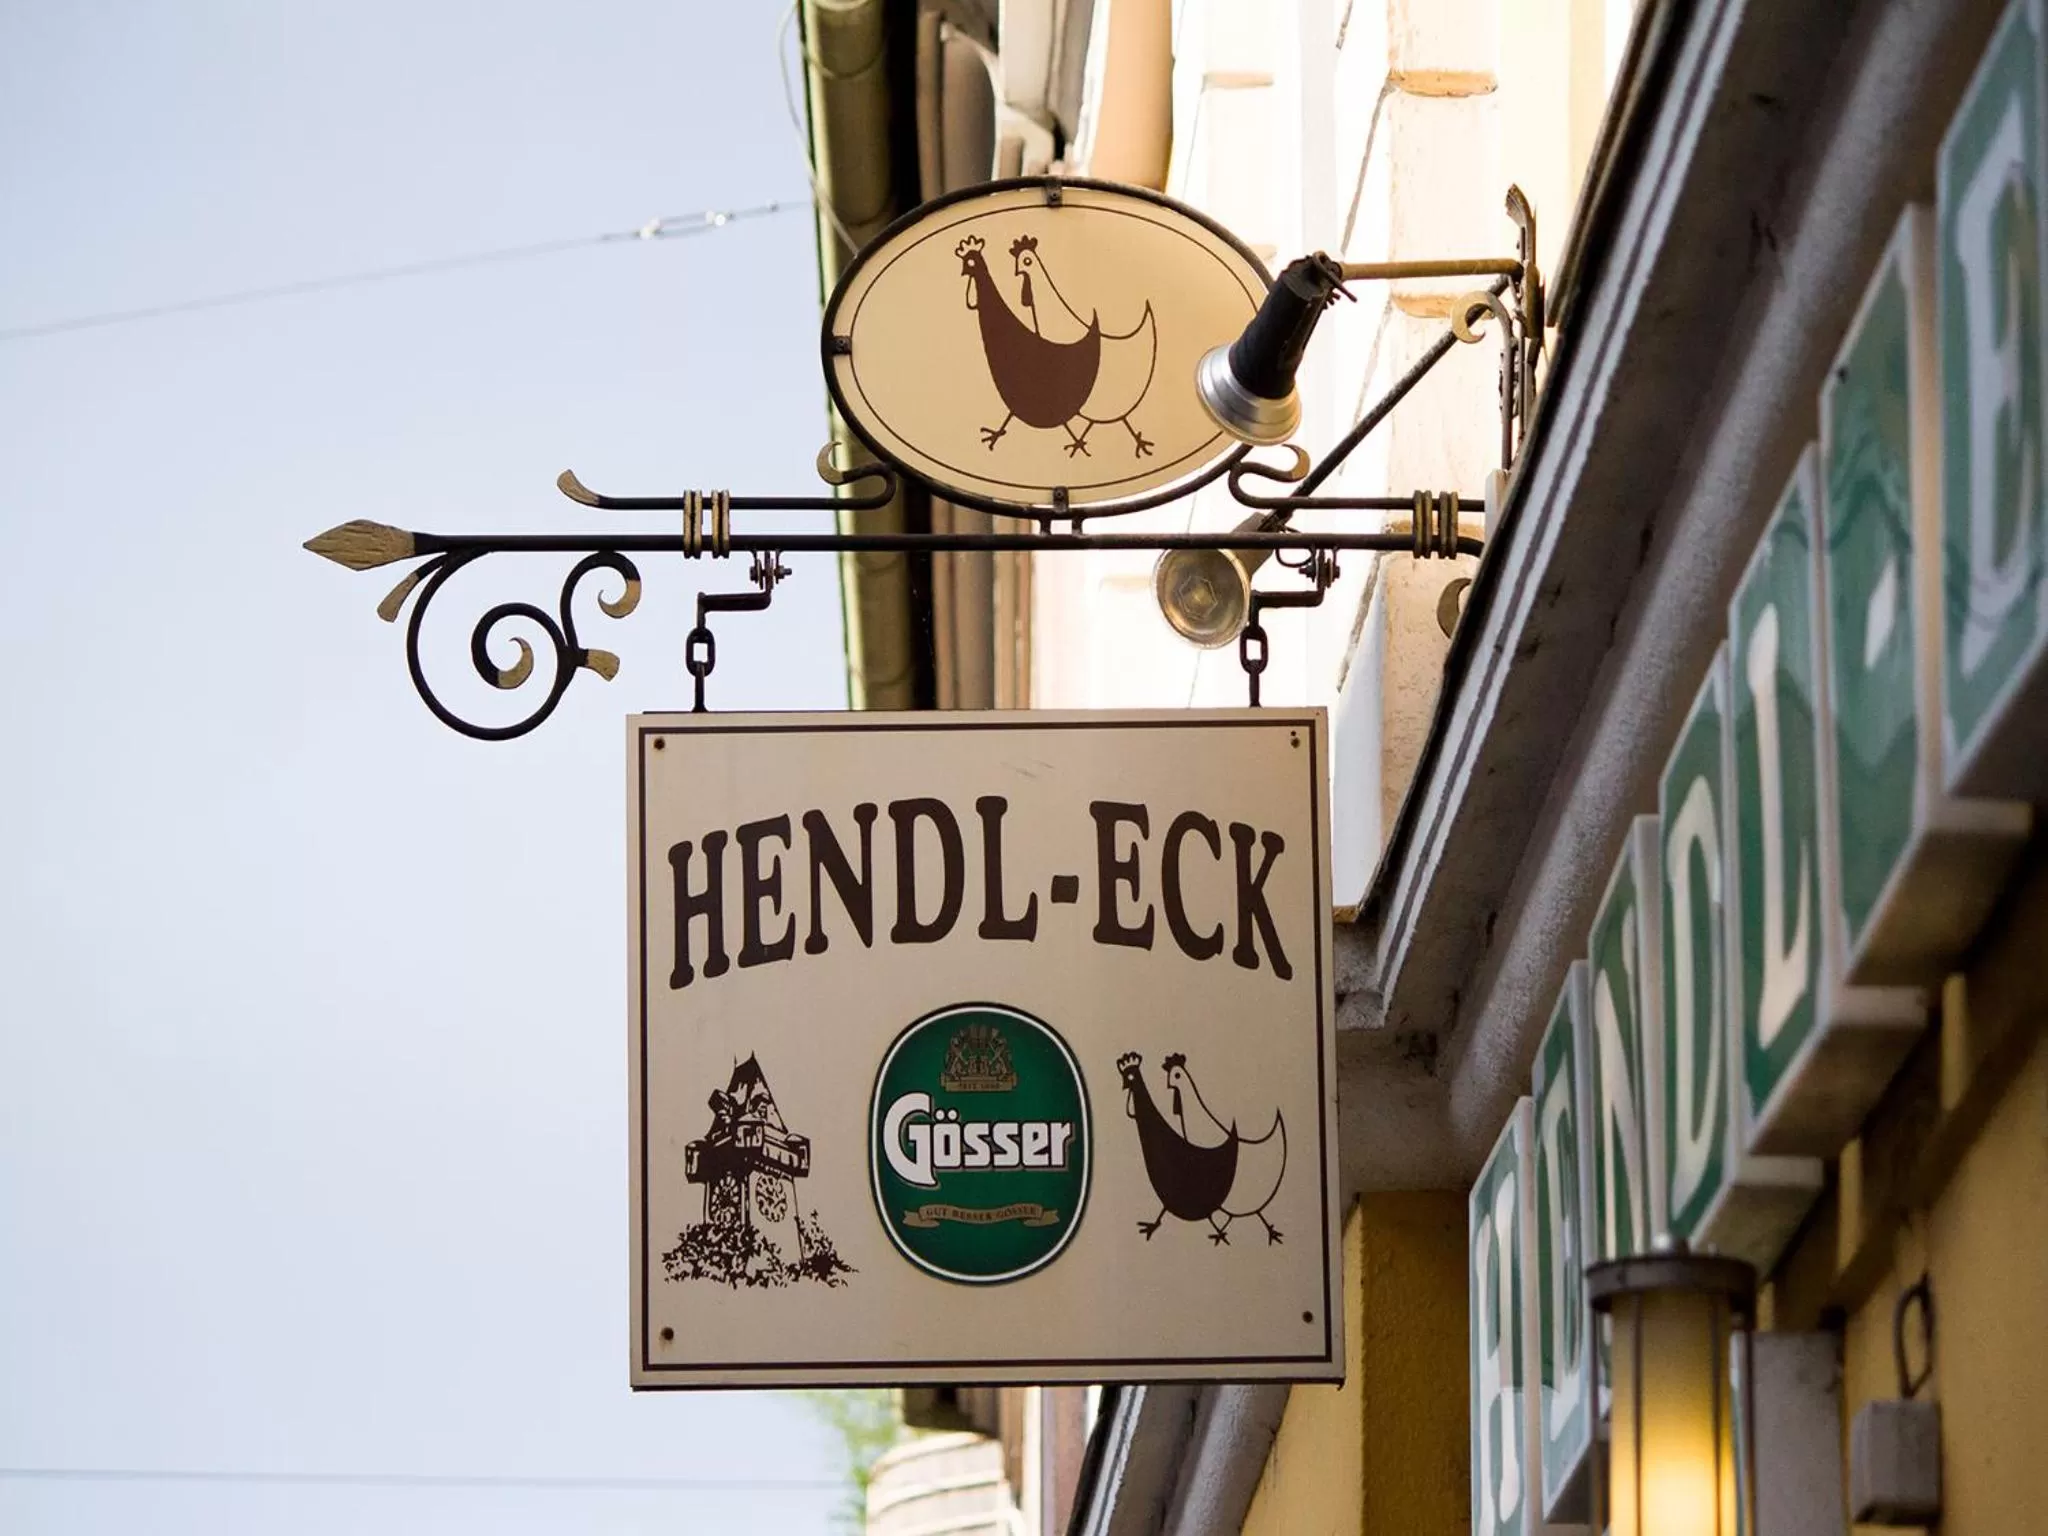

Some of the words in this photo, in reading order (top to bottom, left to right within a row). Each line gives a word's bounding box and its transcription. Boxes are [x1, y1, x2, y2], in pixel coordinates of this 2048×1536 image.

[667, 795, 1293, 990] HENDL-ECK
[882, 1091, 1074, 1188] Gösser
[925, 1206, 948, 1217] GUT
[951, 1209, 993, 1220] BESSER
